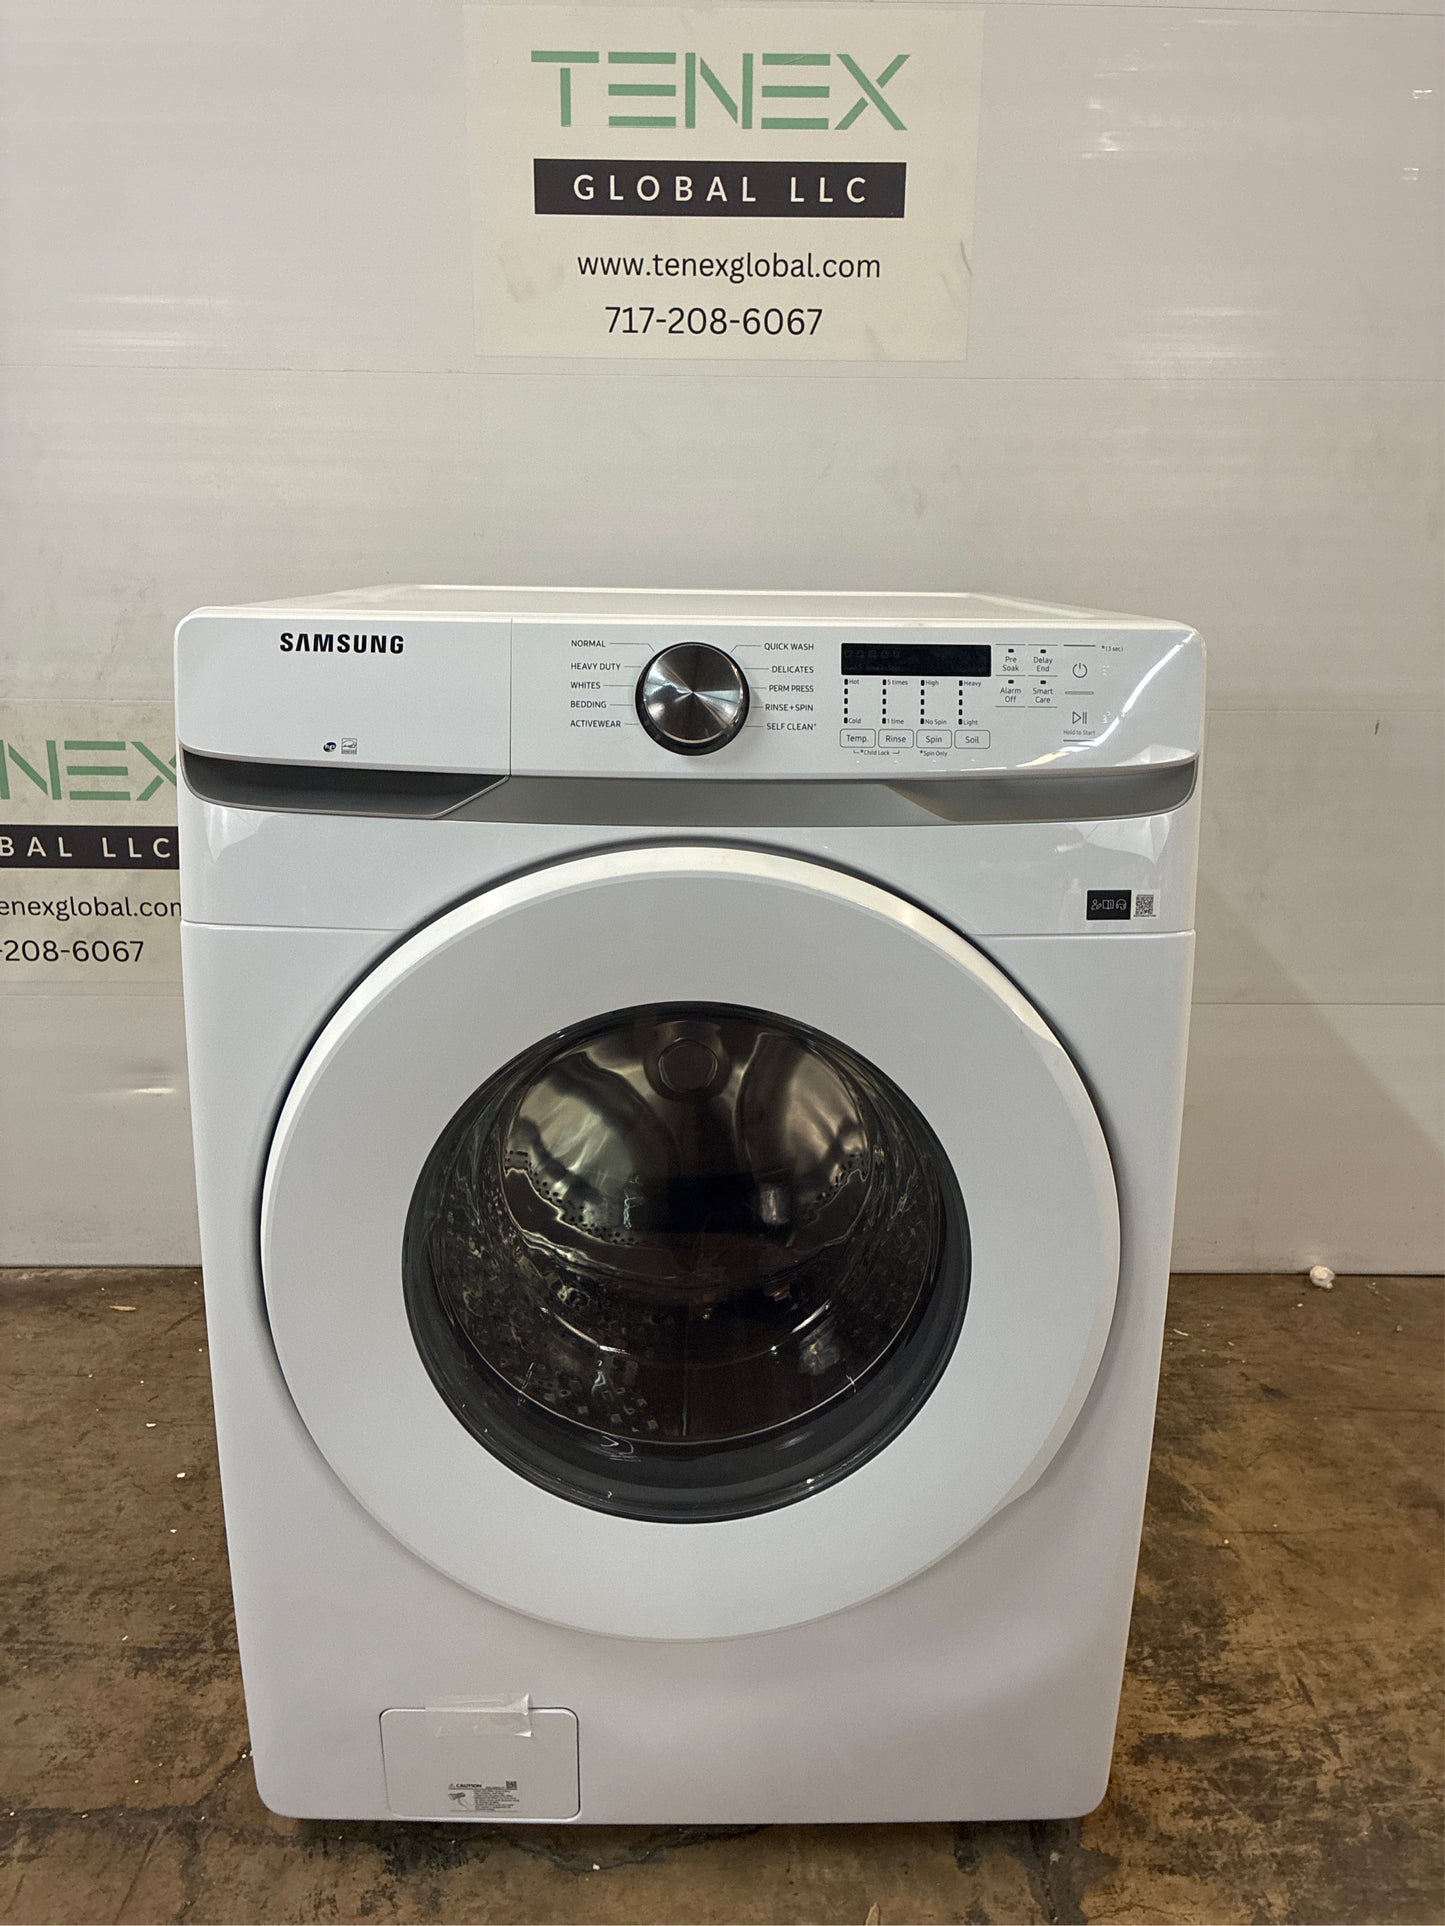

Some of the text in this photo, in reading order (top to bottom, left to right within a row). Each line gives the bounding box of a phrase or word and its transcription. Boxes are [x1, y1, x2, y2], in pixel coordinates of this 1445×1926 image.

[531, 50, 911, 130] TENEX
[573, 174, 867, 203] GLOBAL LLC
[577, 252, 881, 284] www.tenexglobal.com
[604, 306, 824, 336] 717-208-6067
[280, 633, 404, 654] SAMSUNG
[571, 640, 606, 648] NORMAL
[772, 665, 814, 673] DELICATES
[570, 701, 607, 709] BEDDING
[570, 720, 621, 728] ACTIVEWEAR
[846, 734, 868, 743] Temp.
[926, 736, 942, 744] Spin
[102, 837, 171, 858] LLC
[0, 940, 144, 962] 208-6067
